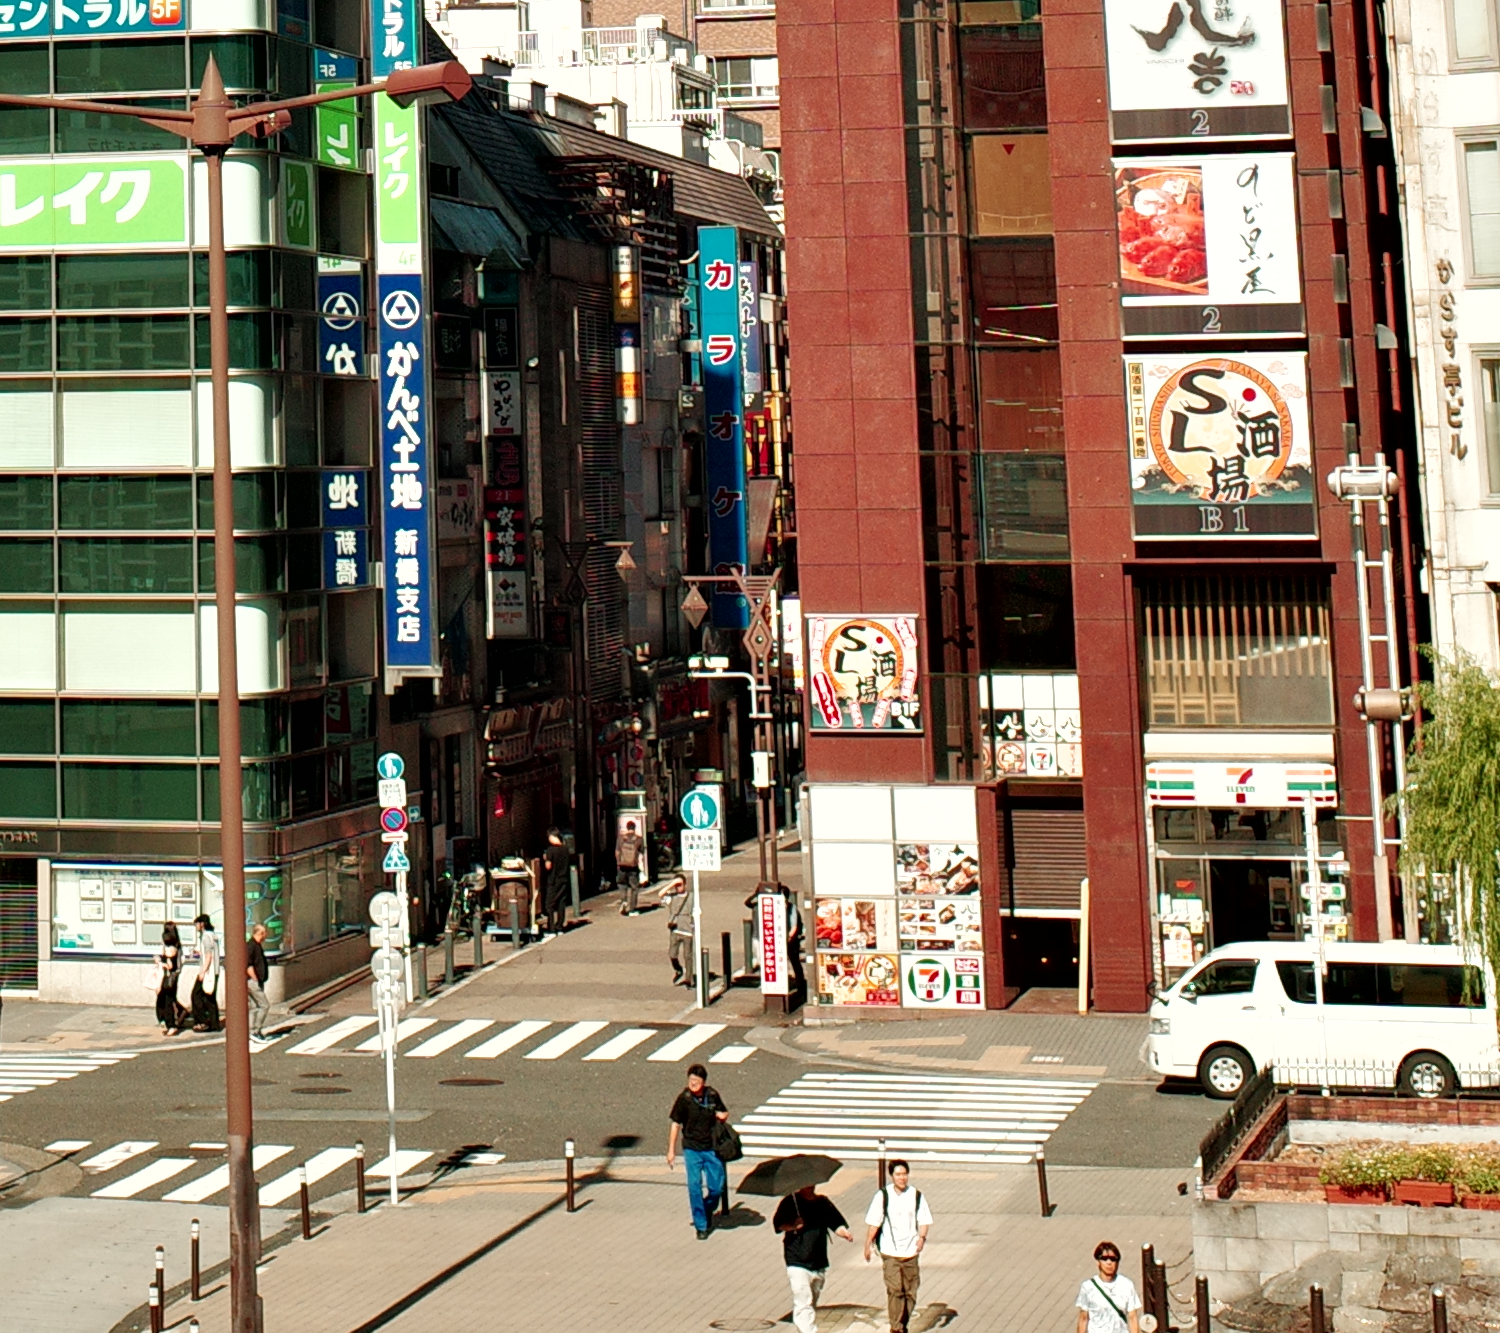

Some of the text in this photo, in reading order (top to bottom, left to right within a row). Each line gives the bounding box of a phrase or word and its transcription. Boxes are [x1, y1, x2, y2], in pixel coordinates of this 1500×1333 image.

[152, 0, 178, 18] 5F
[1191, 110, 1209, 134] 2
[383, 121, 409, 199] レイク
[0, 170, 150, 226] レイク
[398, 250, 417, 267] 4F
[1203, 307, 1221, 332] 2
[386, 341, 422, 510] かんべ土地
[495, 490, 513, 501] 2F
[395, 529, 420, 643] 新橋支店
[891, 702, 919, 717] B1F
